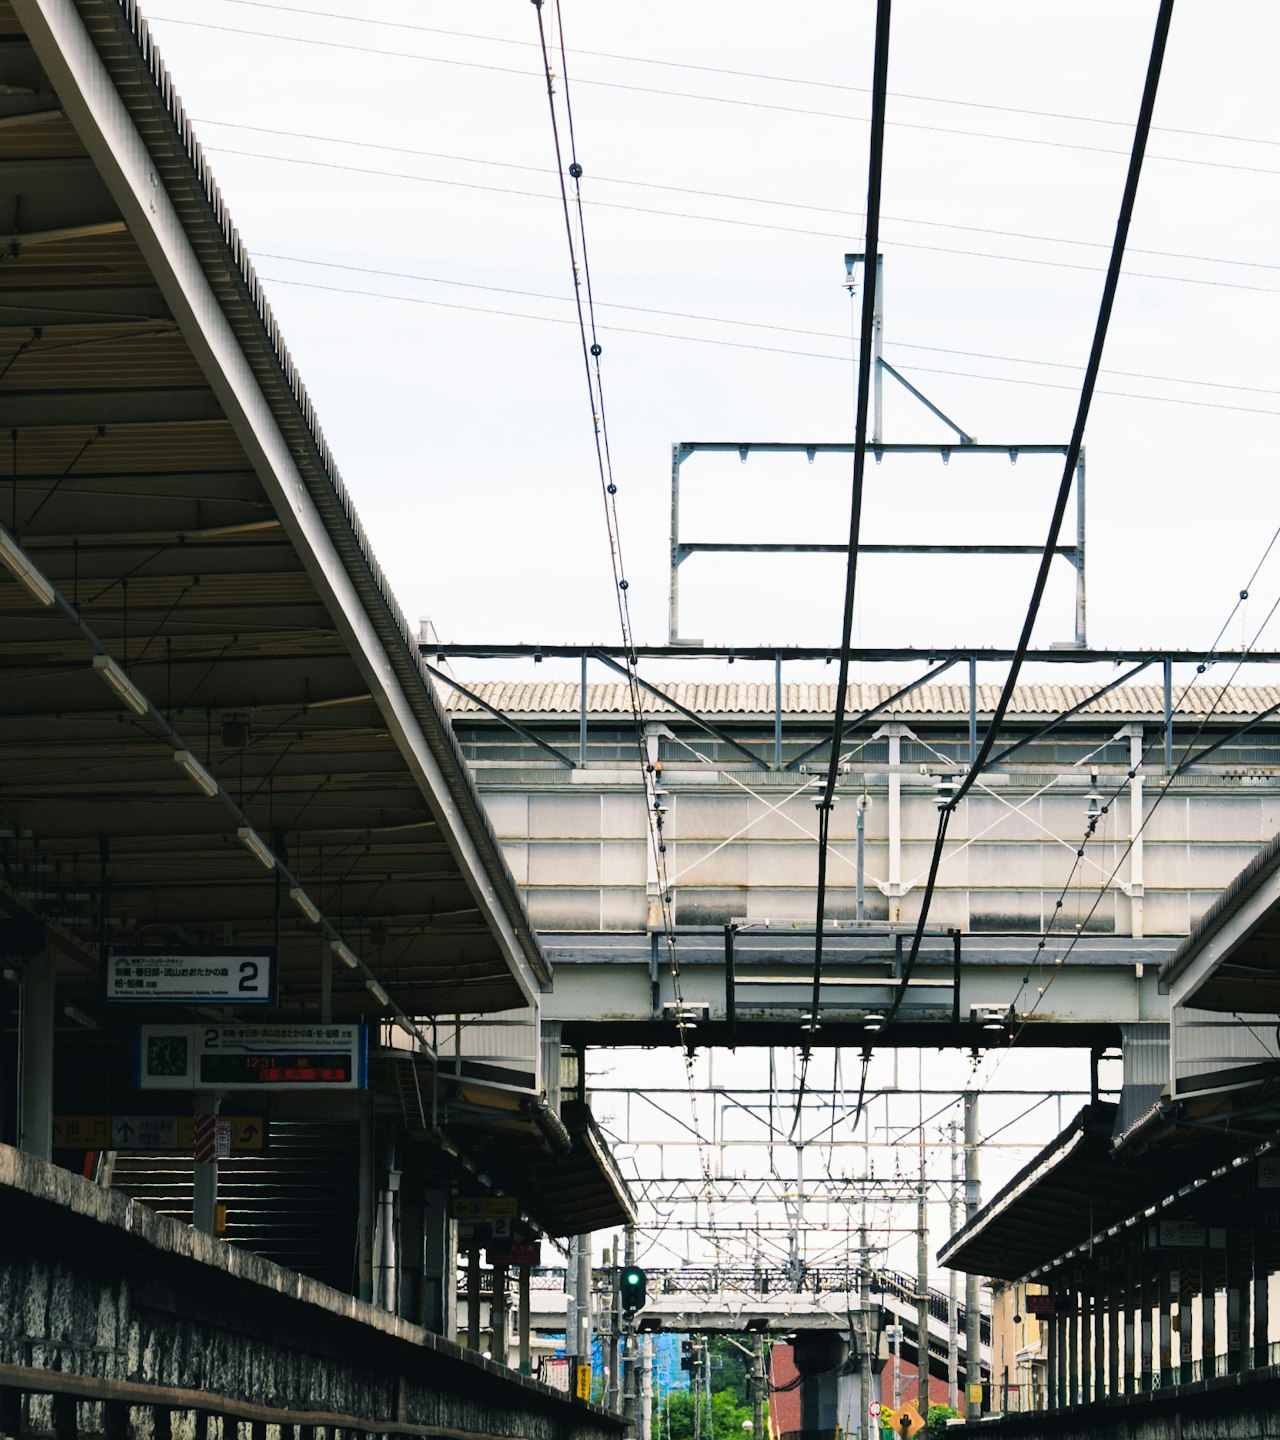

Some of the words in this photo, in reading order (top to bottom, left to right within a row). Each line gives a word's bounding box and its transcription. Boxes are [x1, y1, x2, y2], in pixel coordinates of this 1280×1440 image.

[238, 961, 258, 992] 2
[204, 1029, 219, 1048] 2
[495, 1220, 506, 1234] 2
